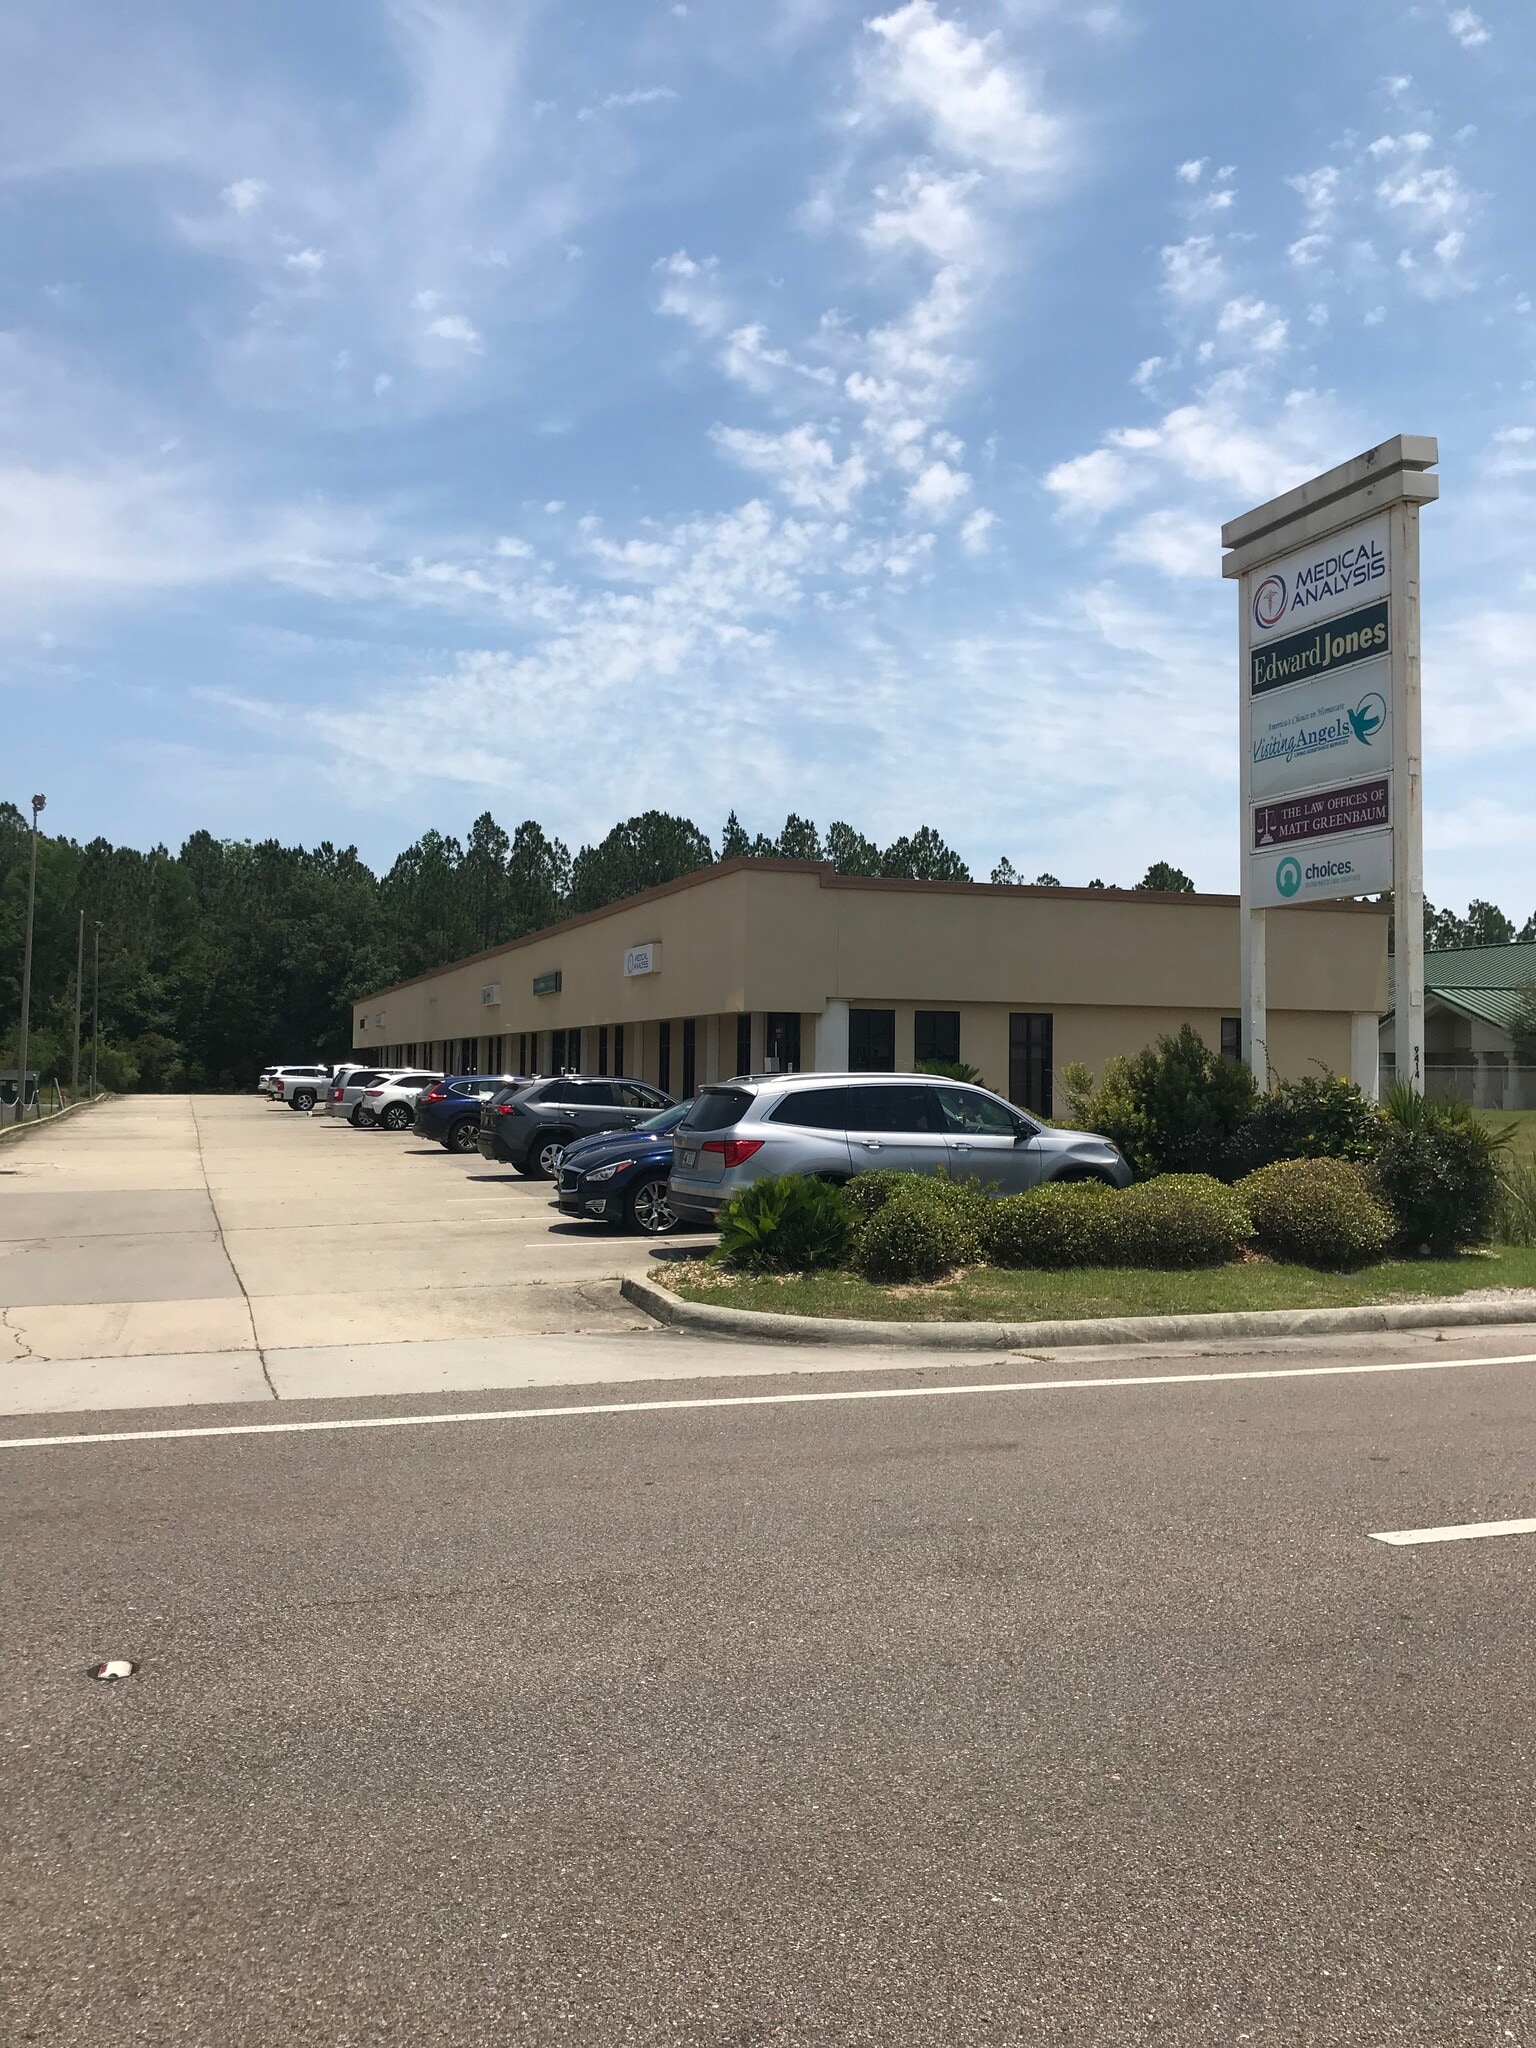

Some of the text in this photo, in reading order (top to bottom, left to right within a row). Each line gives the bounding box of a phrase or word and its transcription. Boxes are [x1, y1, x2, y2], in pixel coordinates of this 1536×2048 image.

[1291, 557, 1386, 611] ANALYSIS
[1296, 540, 1383, 589] MEDICAL
[1279, 805, 1387, 837] MATT GREENBAUM
[1281, 789, 1385, 820] THE LAW OFFICES OF
